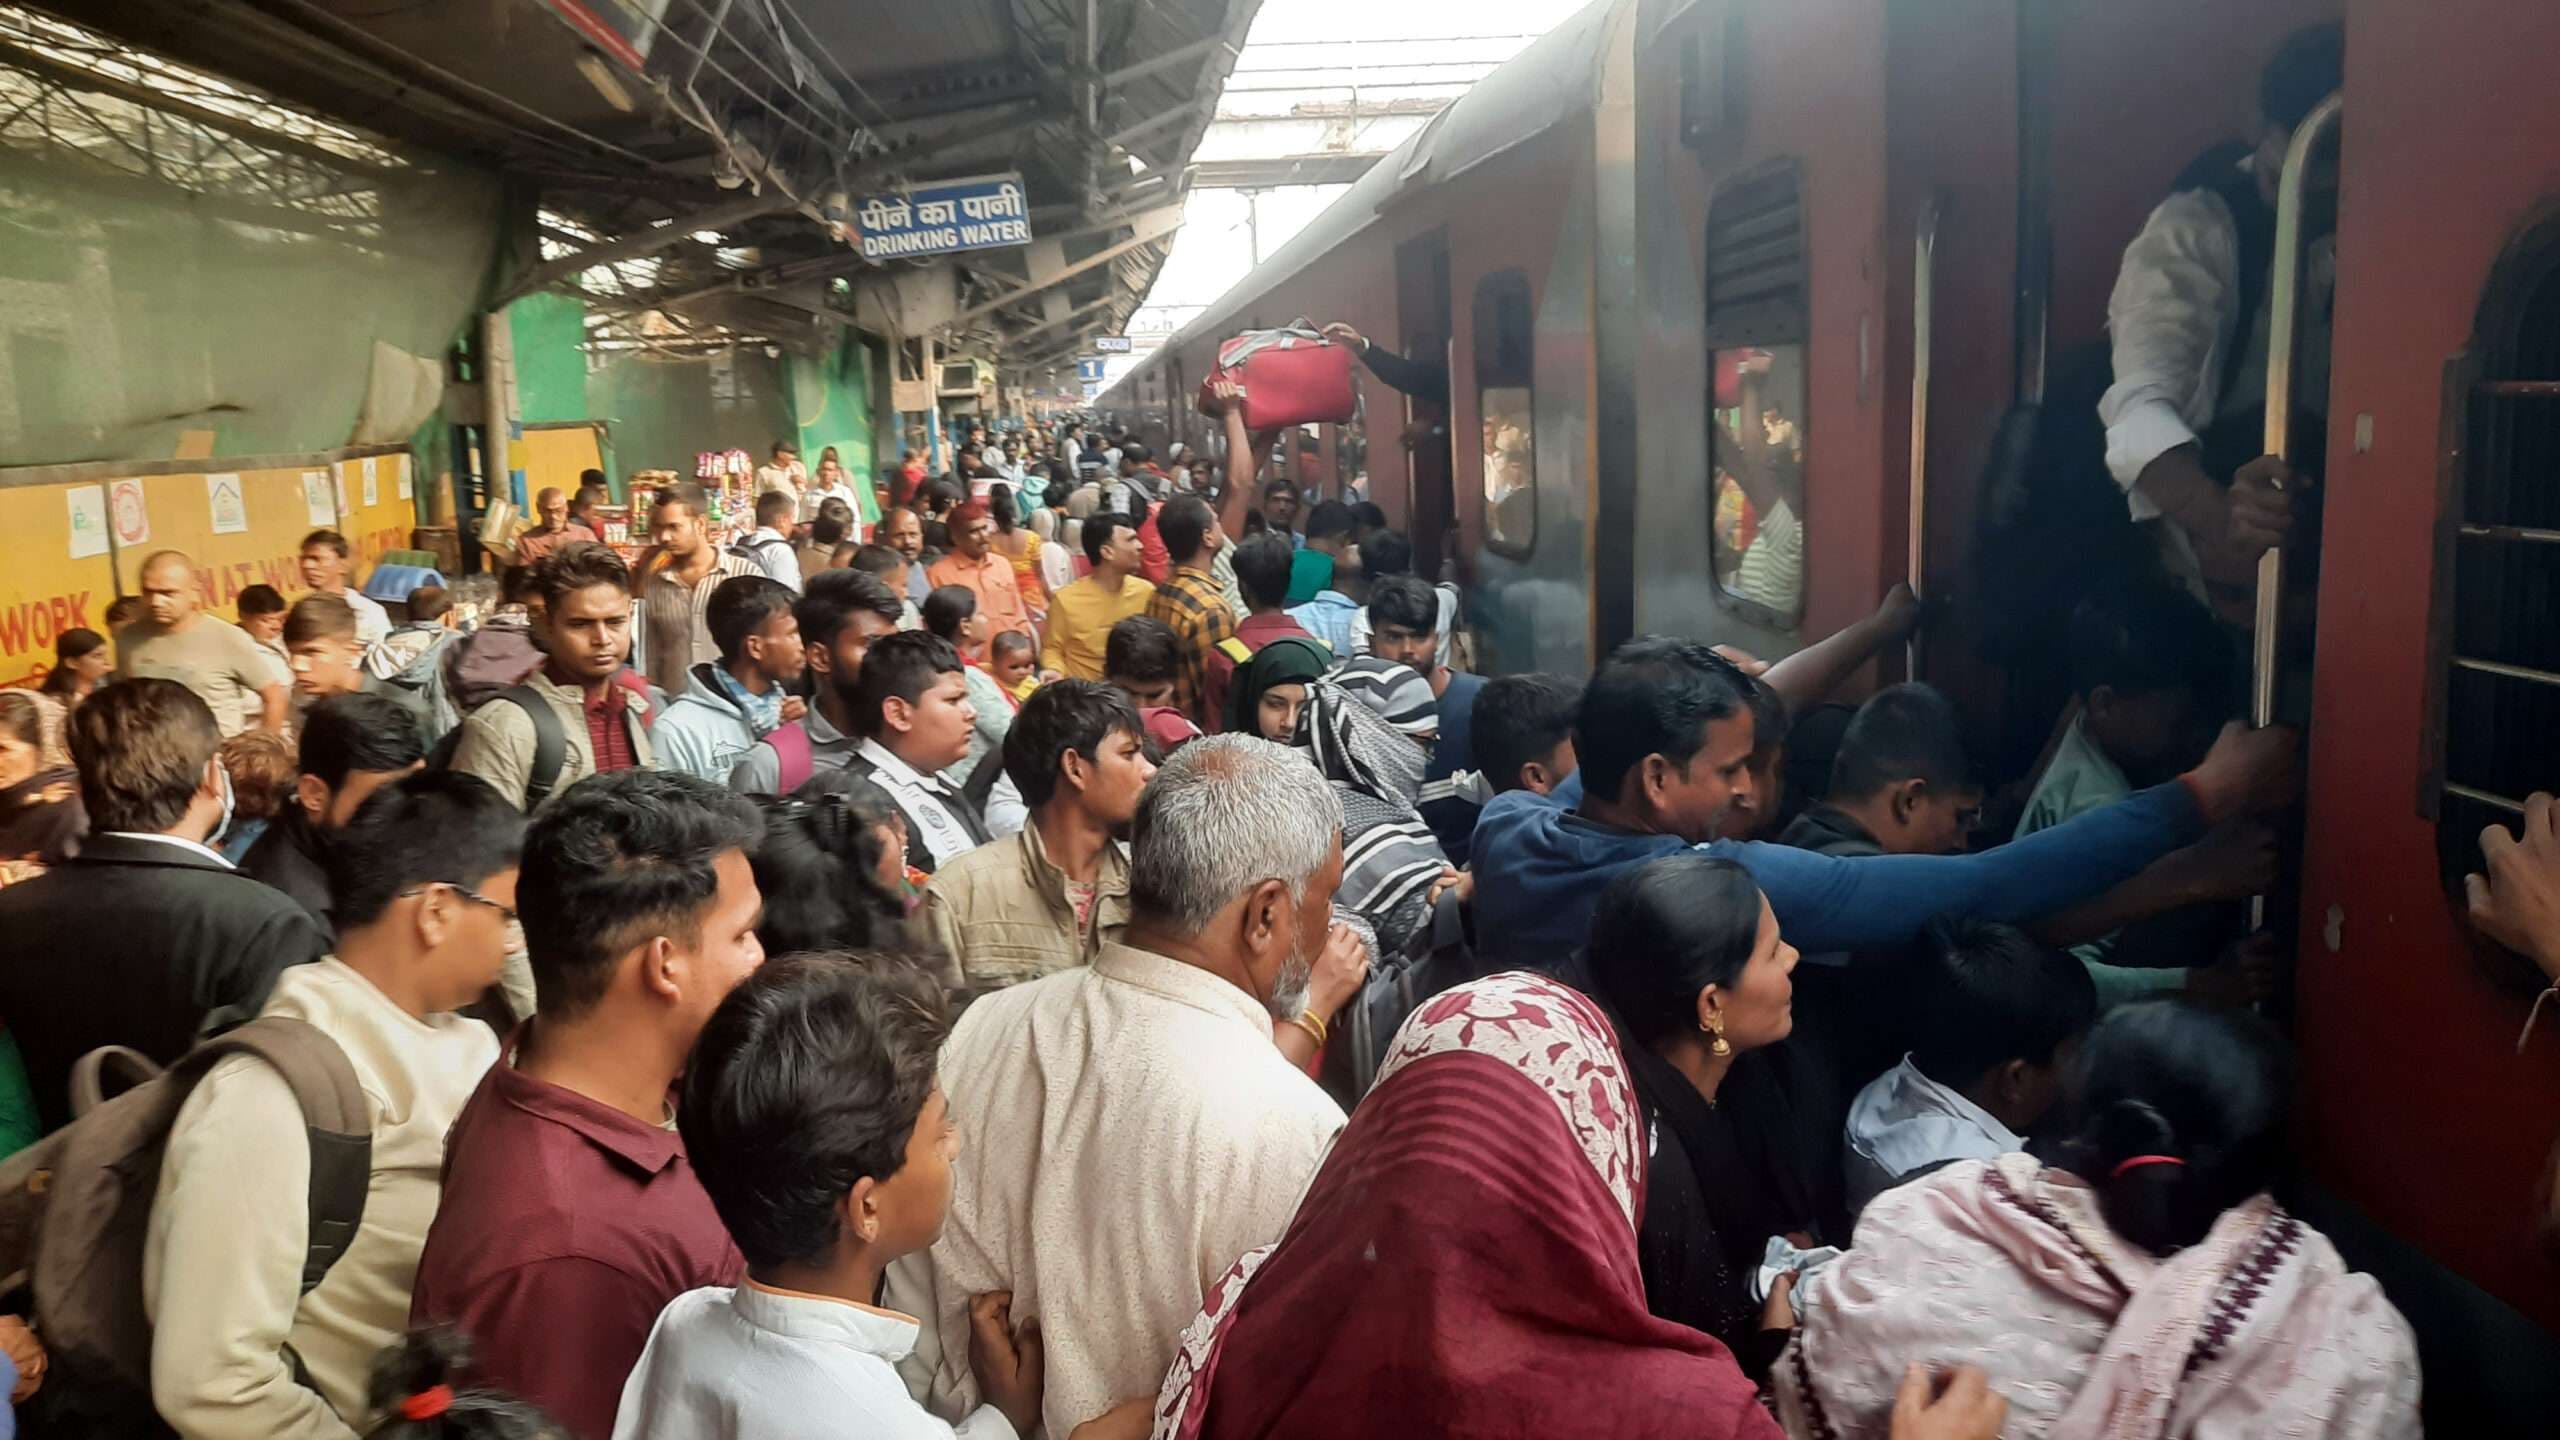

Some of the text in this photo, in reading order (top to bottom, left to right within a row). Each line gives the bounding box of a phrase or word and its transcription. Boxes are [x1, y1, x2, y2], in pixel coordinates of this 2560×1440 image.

[860, 185, 1022, 231] पीने का पानी
[865, 221, 1028, 256] DRINKING WATER
[1084, 361, 1096, 377] 1
